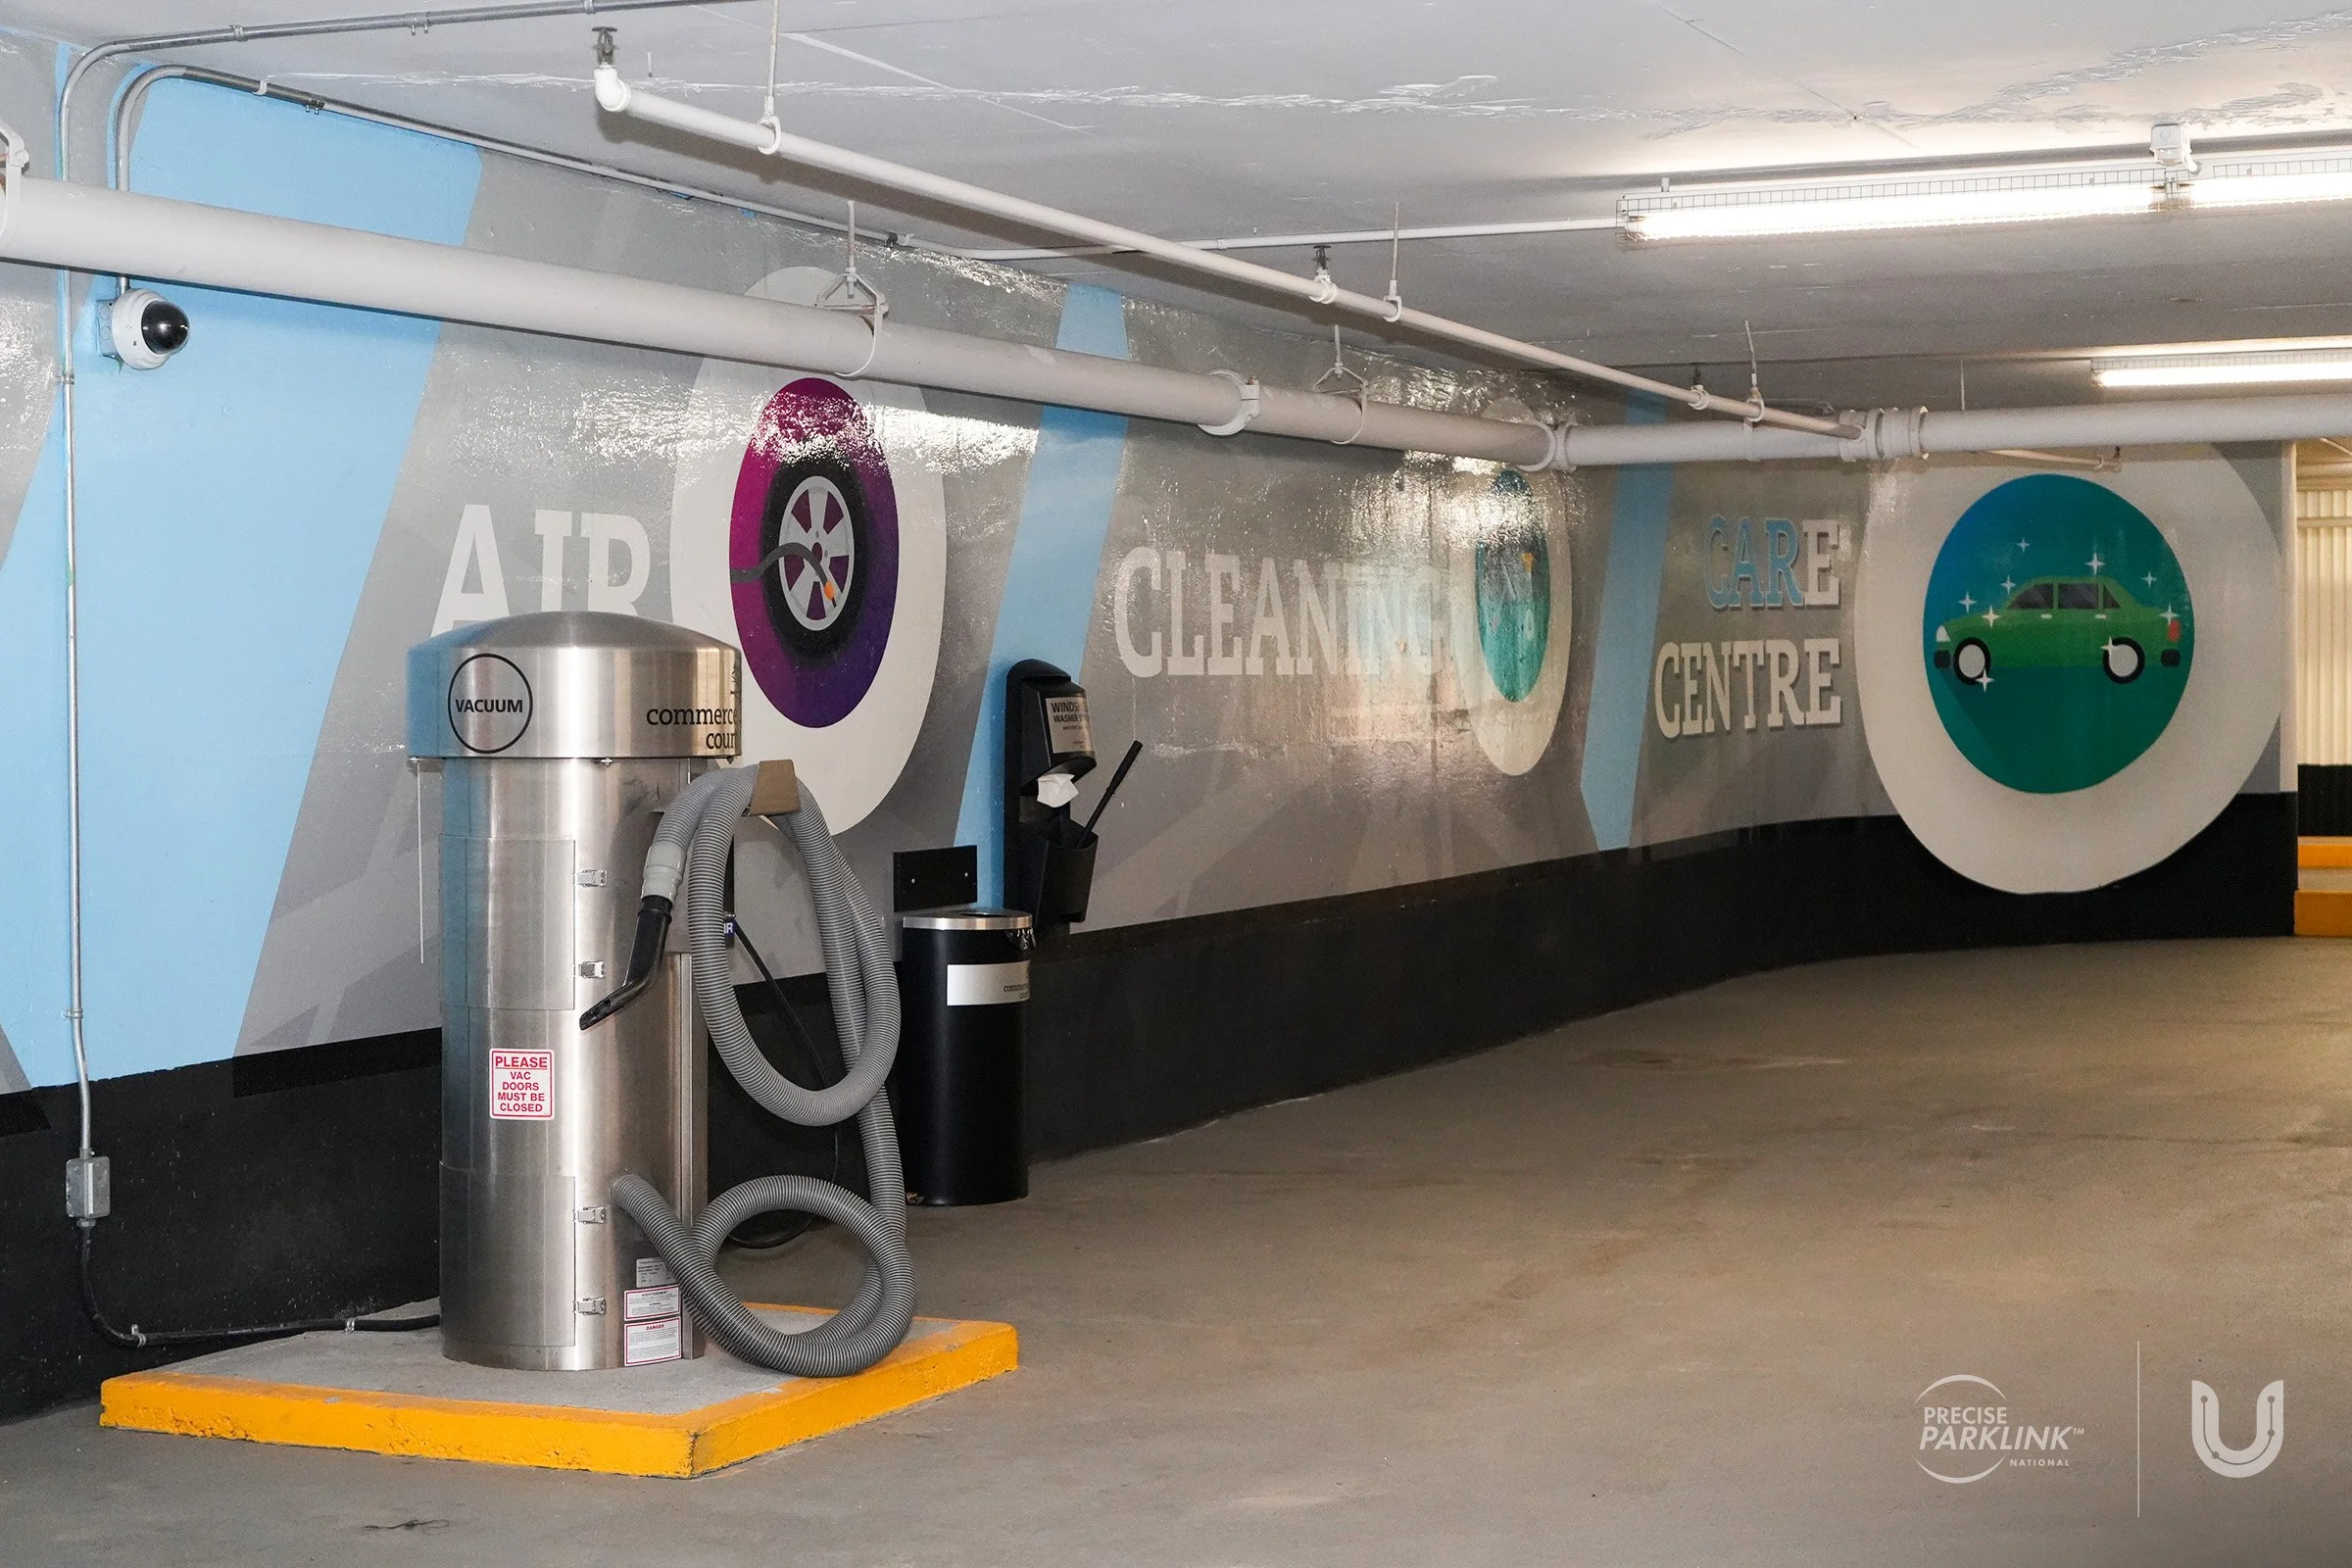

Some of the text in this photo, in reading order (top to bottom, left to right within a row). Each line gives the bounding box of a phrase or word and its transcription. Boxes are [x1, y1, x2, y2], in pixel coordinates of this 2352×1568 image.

[1704, 514, 1840, 610] CARE
[429, 504, 651, 637] AIR
[1113, 546, 1448, 678] CLEANING
[1654, 639, 1841, 738] CENTRE
[455, 699, 523, 712] VACUUM
[706, 732, 737, 749] cour
[723, 922, 733, 934] IR
[495, 1055, 548, 1068] PLEASE
[511, 1071, 531, 1080] VAC
[502, 1082, 539, 1091] DOORS
[498, 1092, 545, 1102] MUST BE
[500, 1102, 543, 1112] CLOSED
